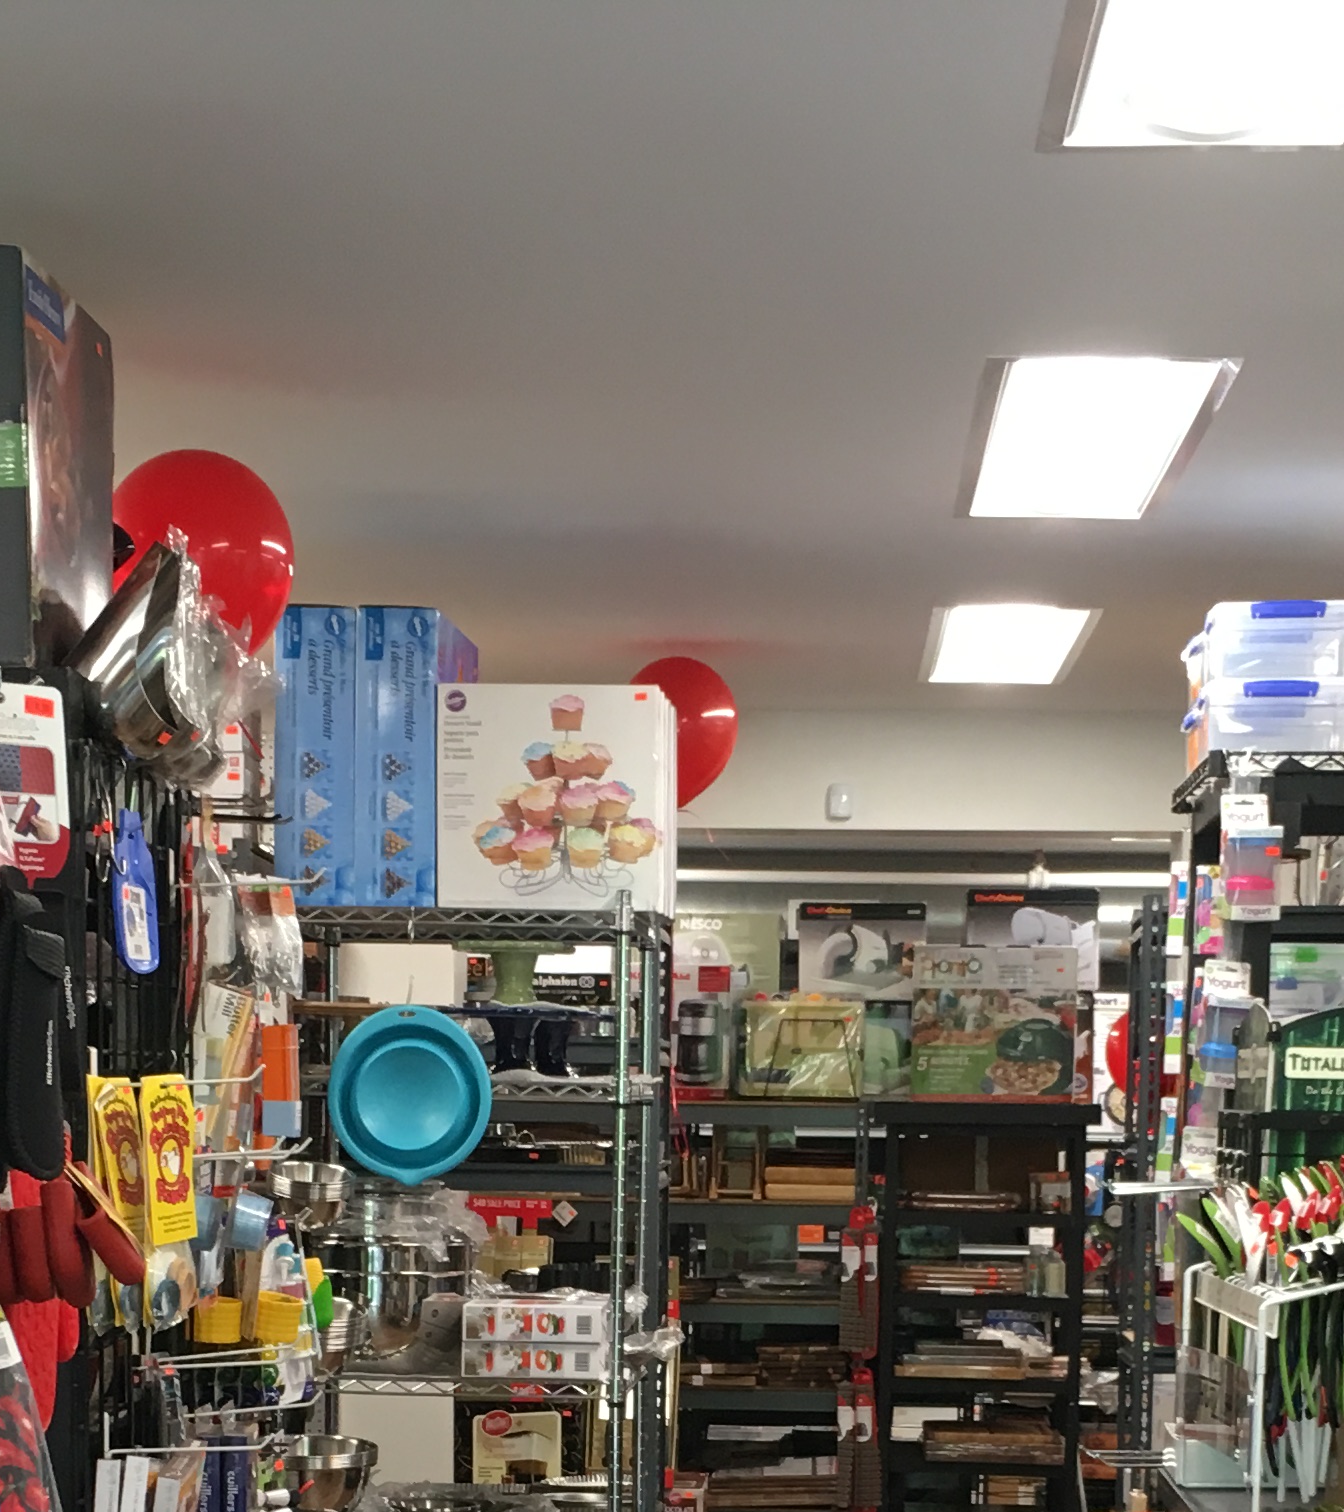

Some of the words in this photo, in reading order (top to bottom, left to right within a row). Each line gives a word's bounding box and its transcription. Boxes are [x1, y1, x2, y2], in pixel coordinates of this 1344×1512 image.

[1226, 812, 1265, 823] Yogurt
[1240, 907, 1273, 917] Yogurt
[679, 918, 723, 931] NESCO
[532, 975, 578, 988] alphalon
[1206, 975, 1247, 991] Yogurt
[221, 992, 237, 1018] Mill
[225, 995, 247, 1037] Butter
[45, 1019, 55, 1086] KitchenGrips
[916, 1056, 929, 1072] 5
[226, 1470, 239, 1512] cuillers
